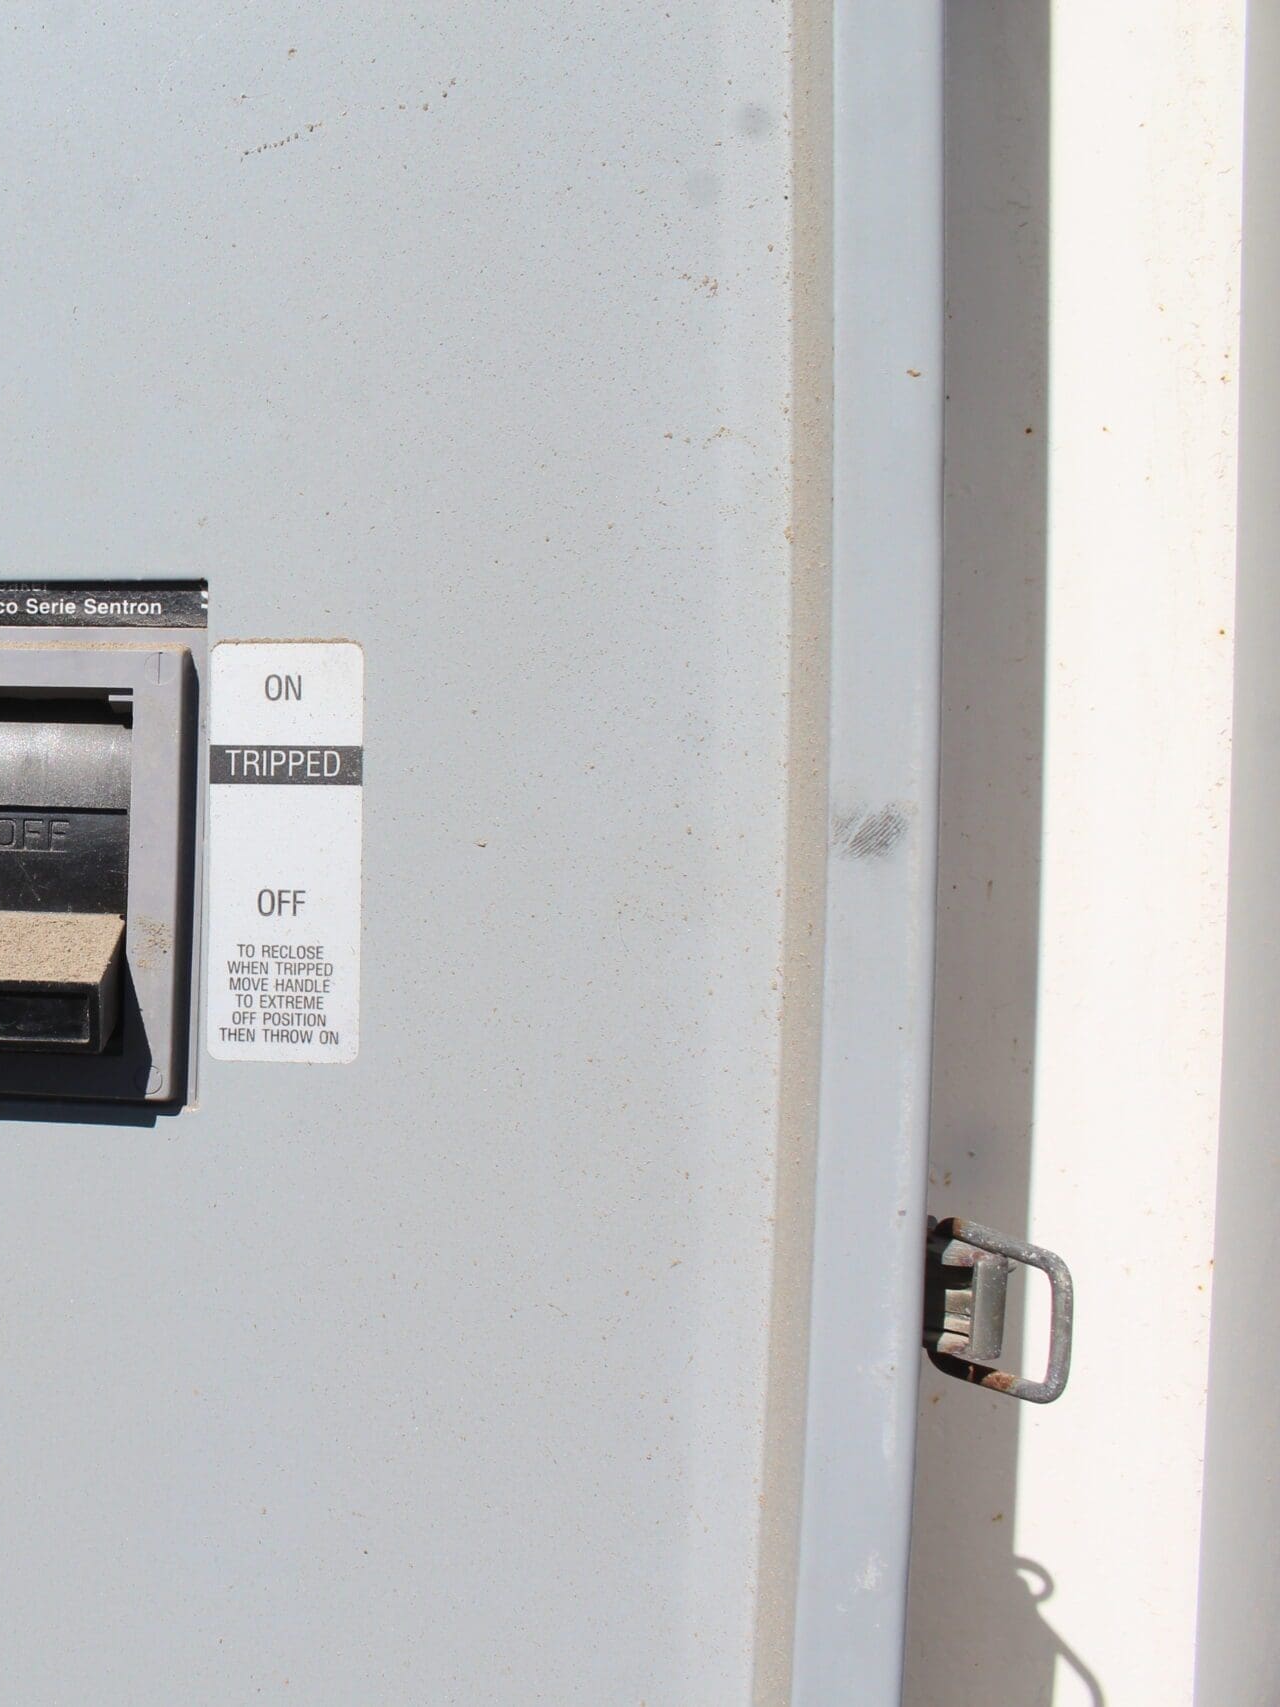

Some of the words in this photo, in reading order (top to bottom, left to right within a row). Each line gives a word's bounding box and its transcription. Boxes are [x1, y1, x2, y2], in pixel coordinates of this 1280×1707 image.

[25, 597, 76, 614] Serie
[83, 599, 161, 616] Sentron
[264, 674, 302, 702] ON
[224, 749, 341, 777] TRIPPED
[257, 888, 306, 917] OFF
[237, 943, 255, 958] TO
[261, 944, 324, 960] RECLOSE
[227, 960, 269, 975] WHEN
[275, 961, 334, 977] TRIPPED
[229, 977, 268, 992] MOVE
[275, 978, 330, 993] HANDLE
[235, 993, 253, 1009] TO
[259, 994, 324, 1010] EXTREME
[231, 1011, 257, 1025] OFF
[263, 1011, 327, 1027] POSITION
[219, 1027, 256, 1042] THEN
[262, 1028, 313, 1044] THROW
[319, 1030, 339, 1045] ON
